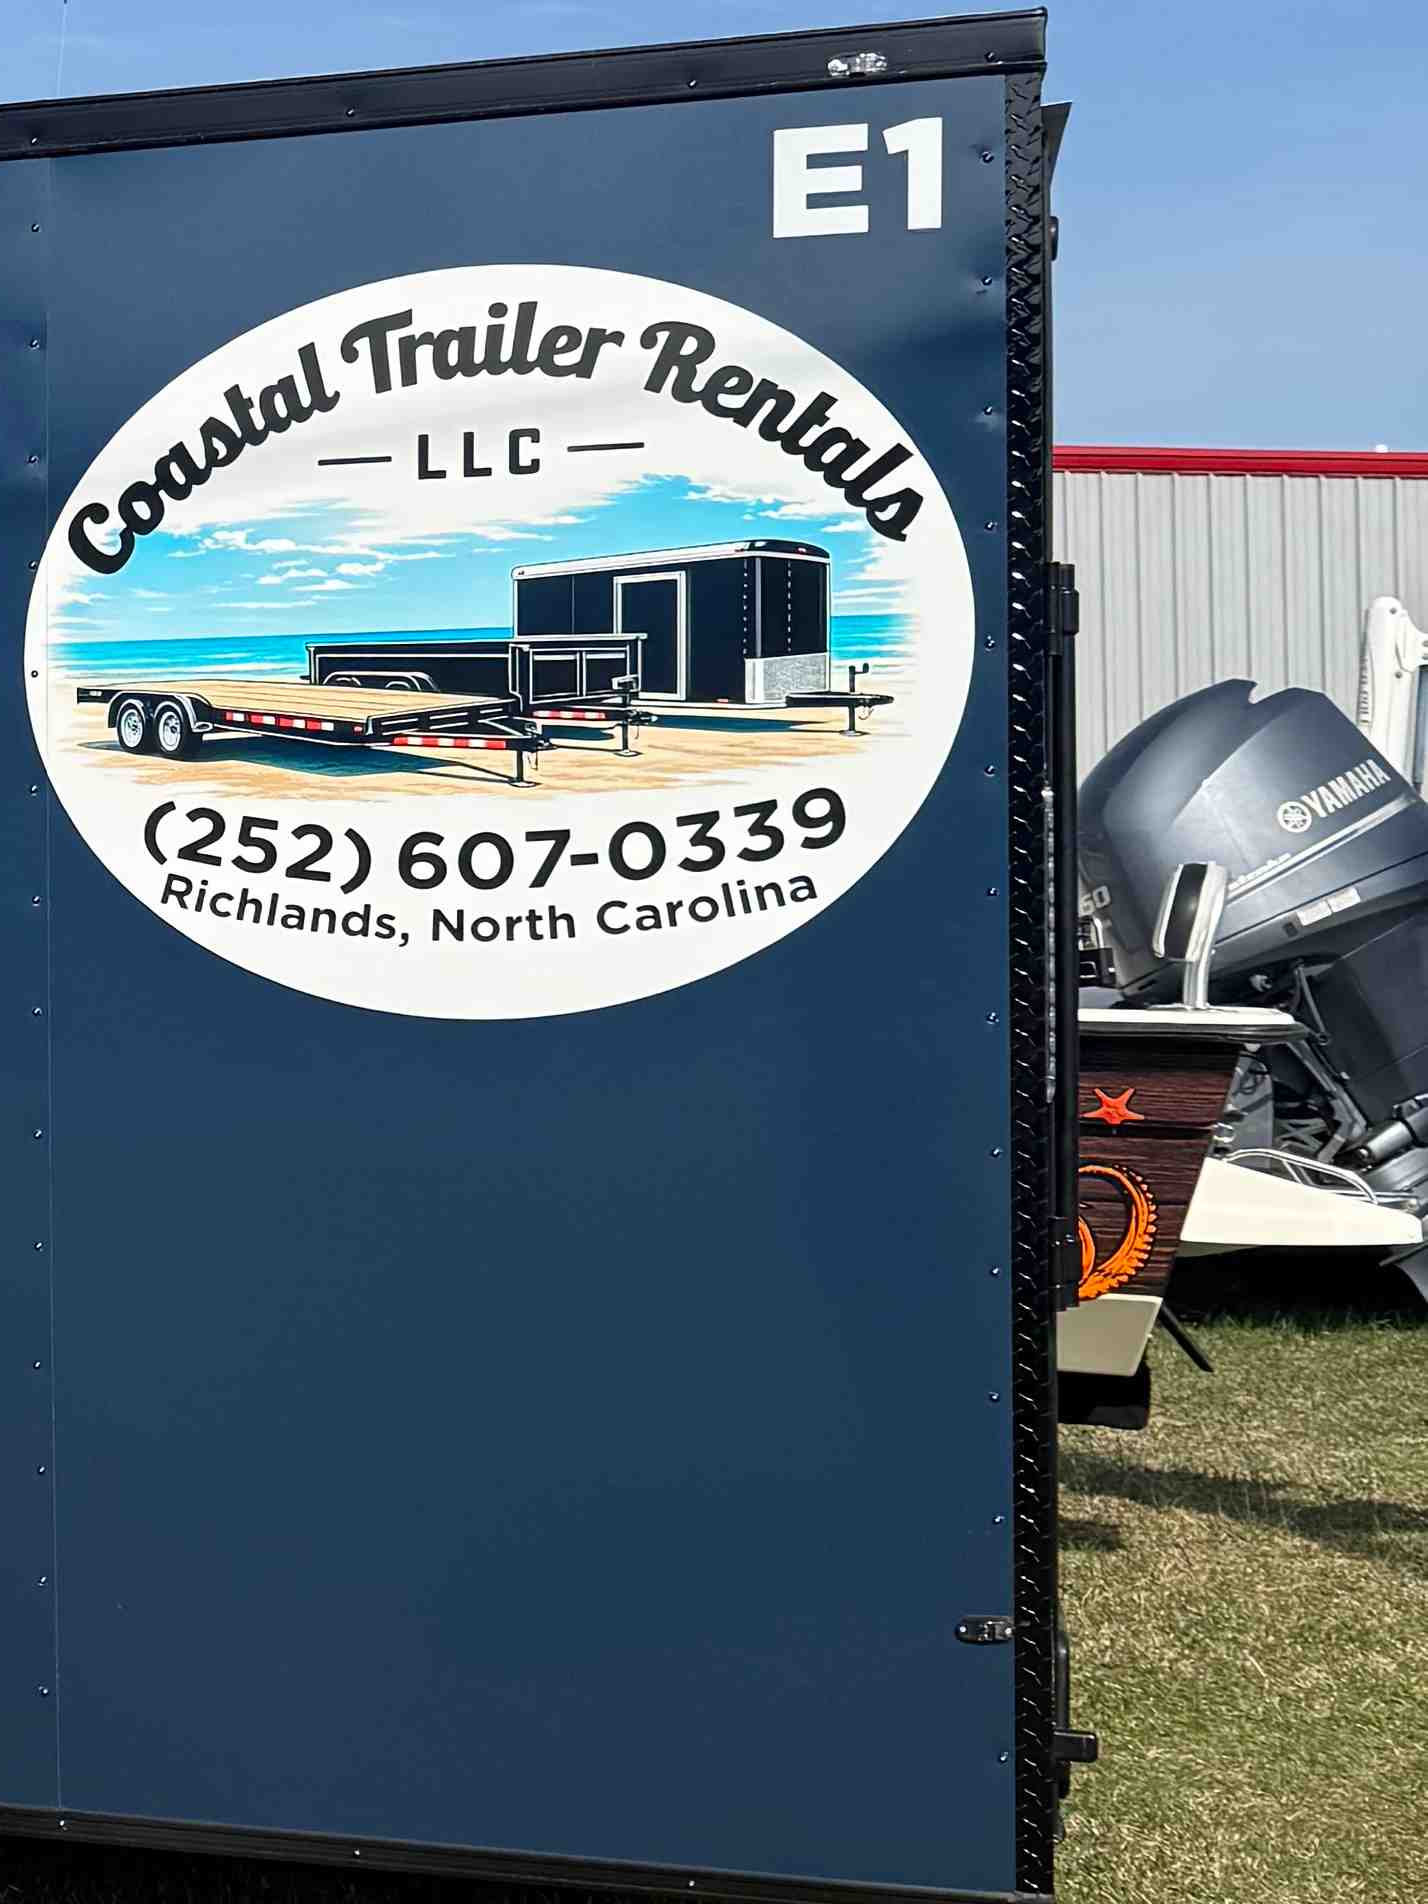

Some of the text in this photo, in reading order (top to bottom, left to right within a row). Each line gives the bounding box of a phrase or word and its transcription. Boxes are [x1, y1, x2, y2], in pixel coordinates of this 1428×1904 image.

[772, 116, 943, 239] E1
[67, 301, 924, 575] Coastal Trailer Rentals
[418, 428, 541, 480] LLC
[1300, 758, 1392, 819] YAMAHA
[144, 787, 846, 895] (252) 607-0339
[160, 873, 818, 947] Richlands, North Carolina
